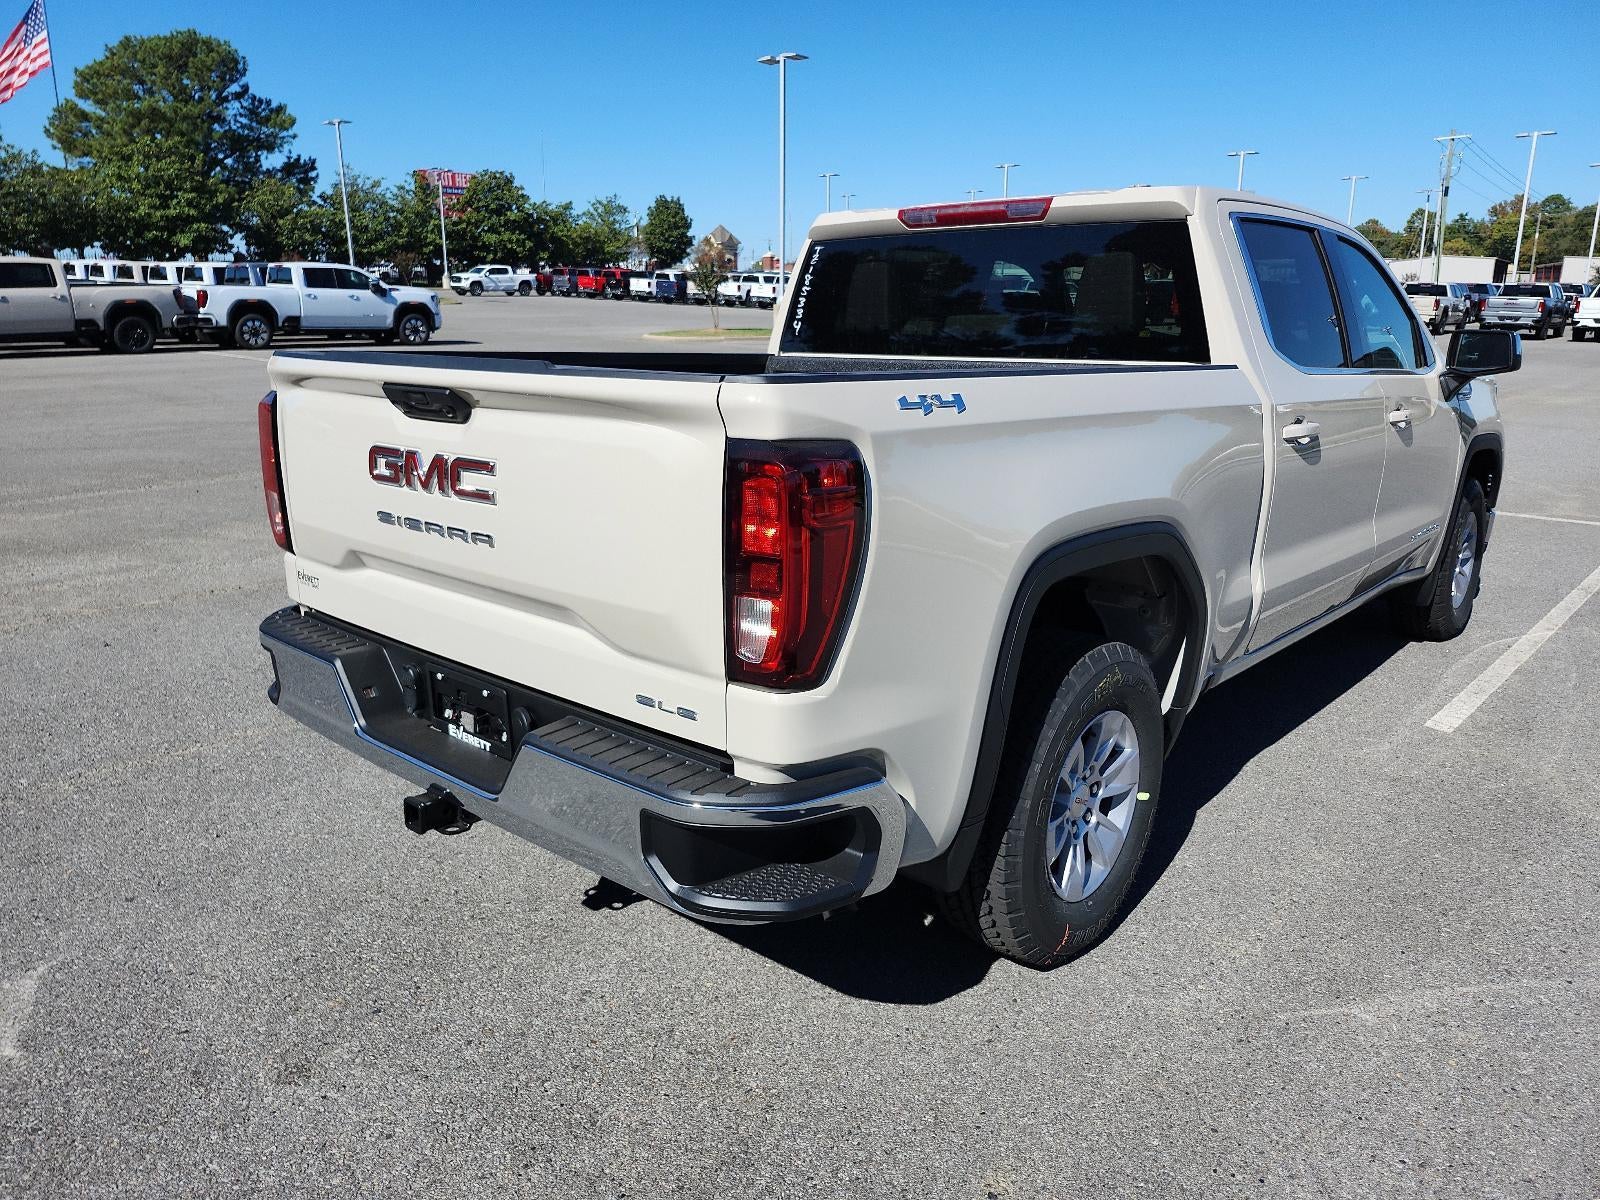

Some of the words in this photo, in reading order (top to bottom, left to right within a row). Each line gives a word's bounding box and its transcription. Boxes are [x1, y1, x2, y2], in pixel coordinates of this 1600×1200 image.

[368, 444, 497, 505] GMC
[377, 510, 496, 549] SIERRA
[636, 694, 698, 721] SLE
[447, 723, 492, 752] EVERETT
